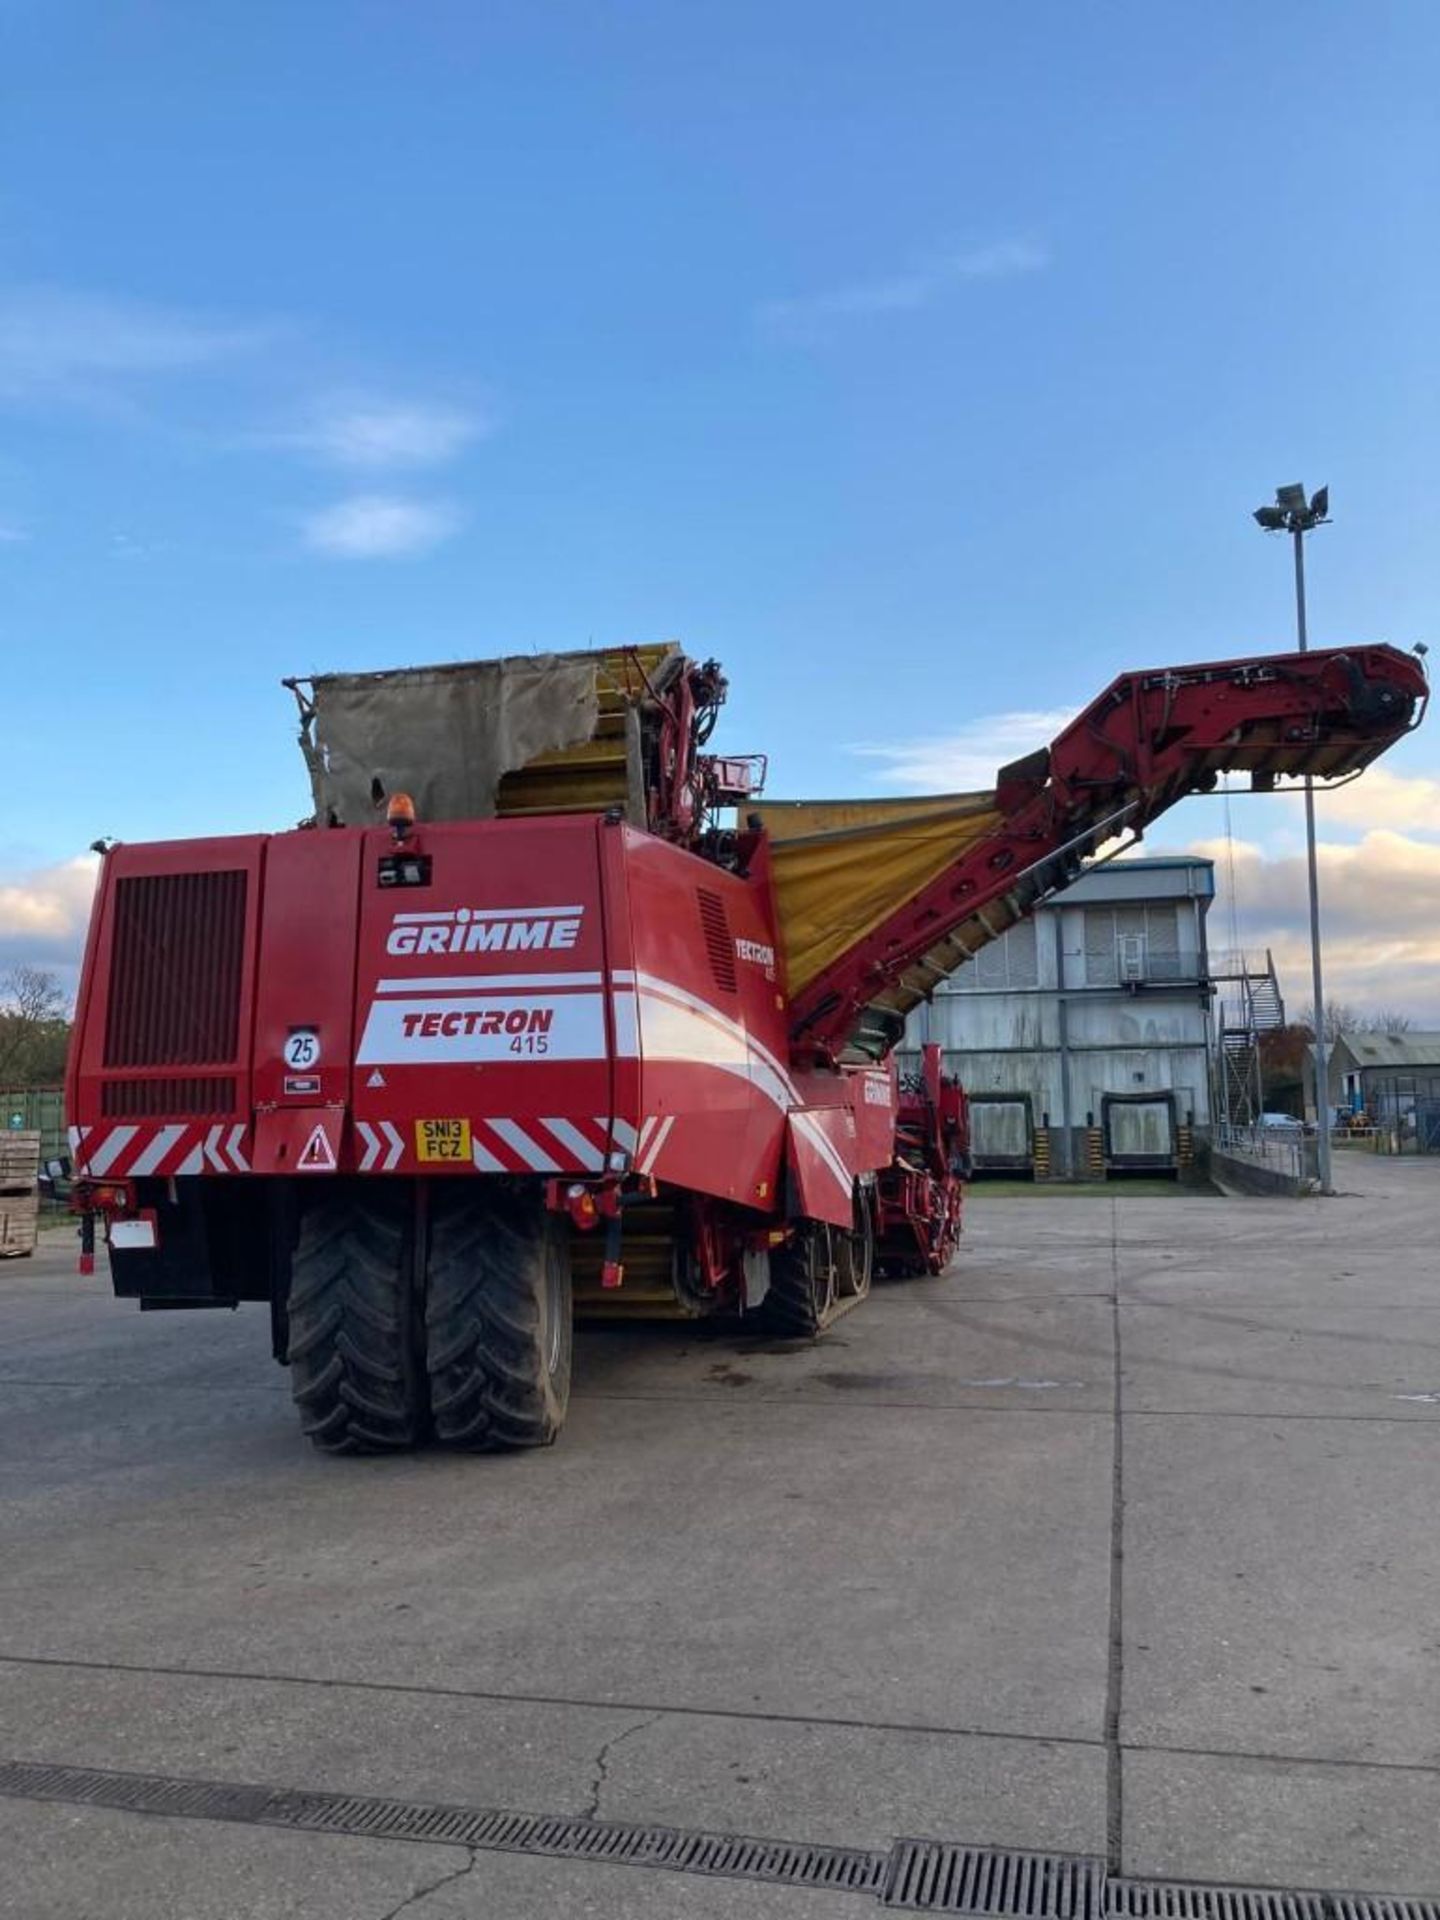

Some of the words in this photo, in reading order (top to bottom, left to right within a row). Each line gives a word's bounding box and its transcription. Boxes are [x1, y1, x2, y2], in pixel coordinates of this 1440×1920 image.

[386, 907, 581, 955] GRIMME
[402, 1009, 553, 1037] TECTRON
[291, 1038, 313, 1062] 25
[509, 1035, 548, 1054] 415
[423, 1121, 462, 1138] SN13
[427, 1140, 462, 1157] FCZ
